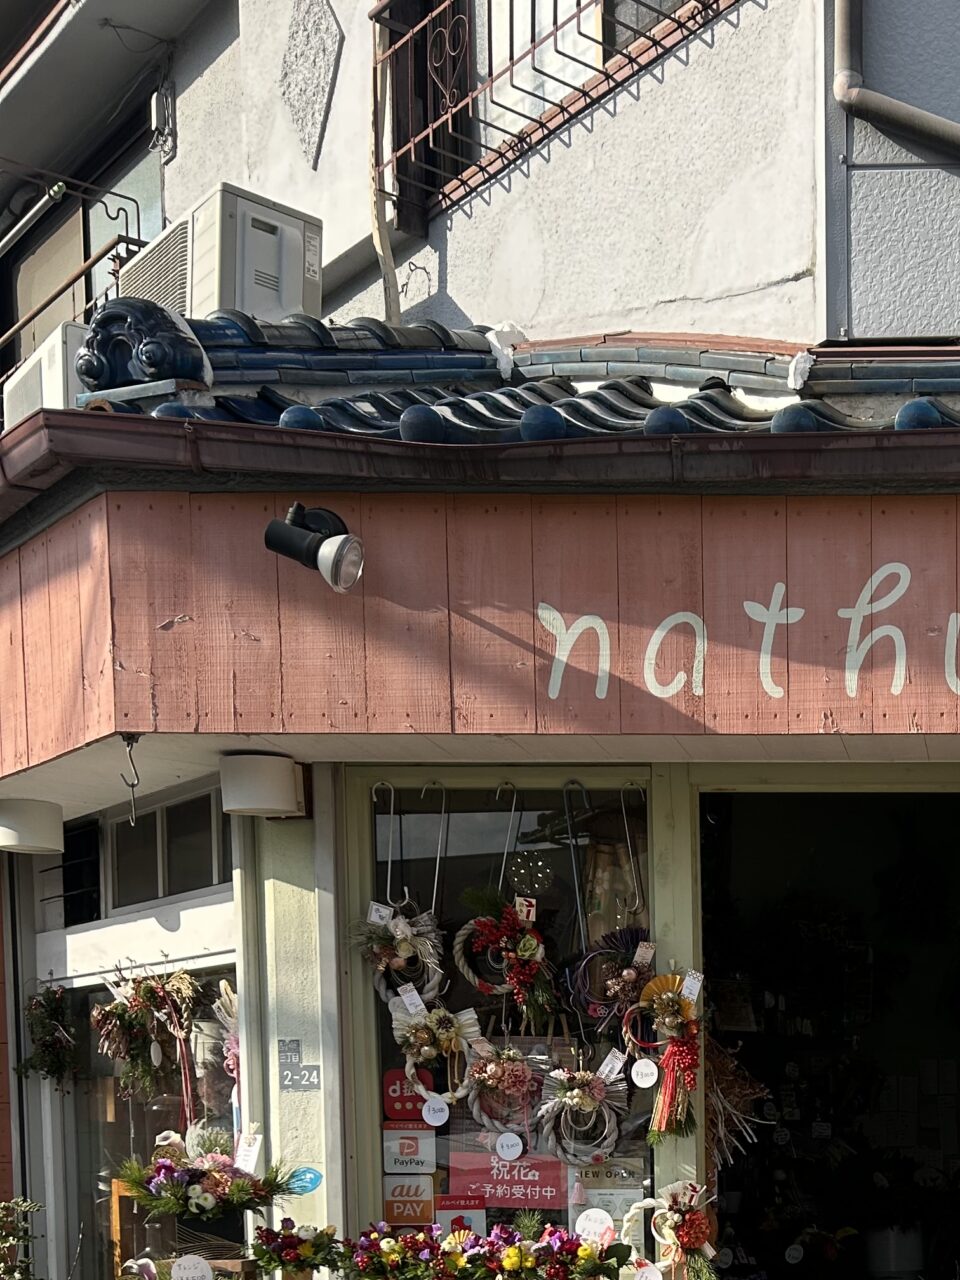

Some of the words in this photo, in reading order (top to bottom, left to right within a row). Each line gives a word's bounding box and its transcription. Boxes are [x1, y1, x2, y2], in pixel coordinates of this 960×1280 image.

[283, 1070, 319, 1085] 2-24
[393, 1158, 425, 1167] PayPay
[490, 1157, 532, 1180] 祝花
[391, 1184, 426, 1198] au
[467, 1183, 556, 1200] ご予約受付中
[393, 1203, 425, 1217] PAY
